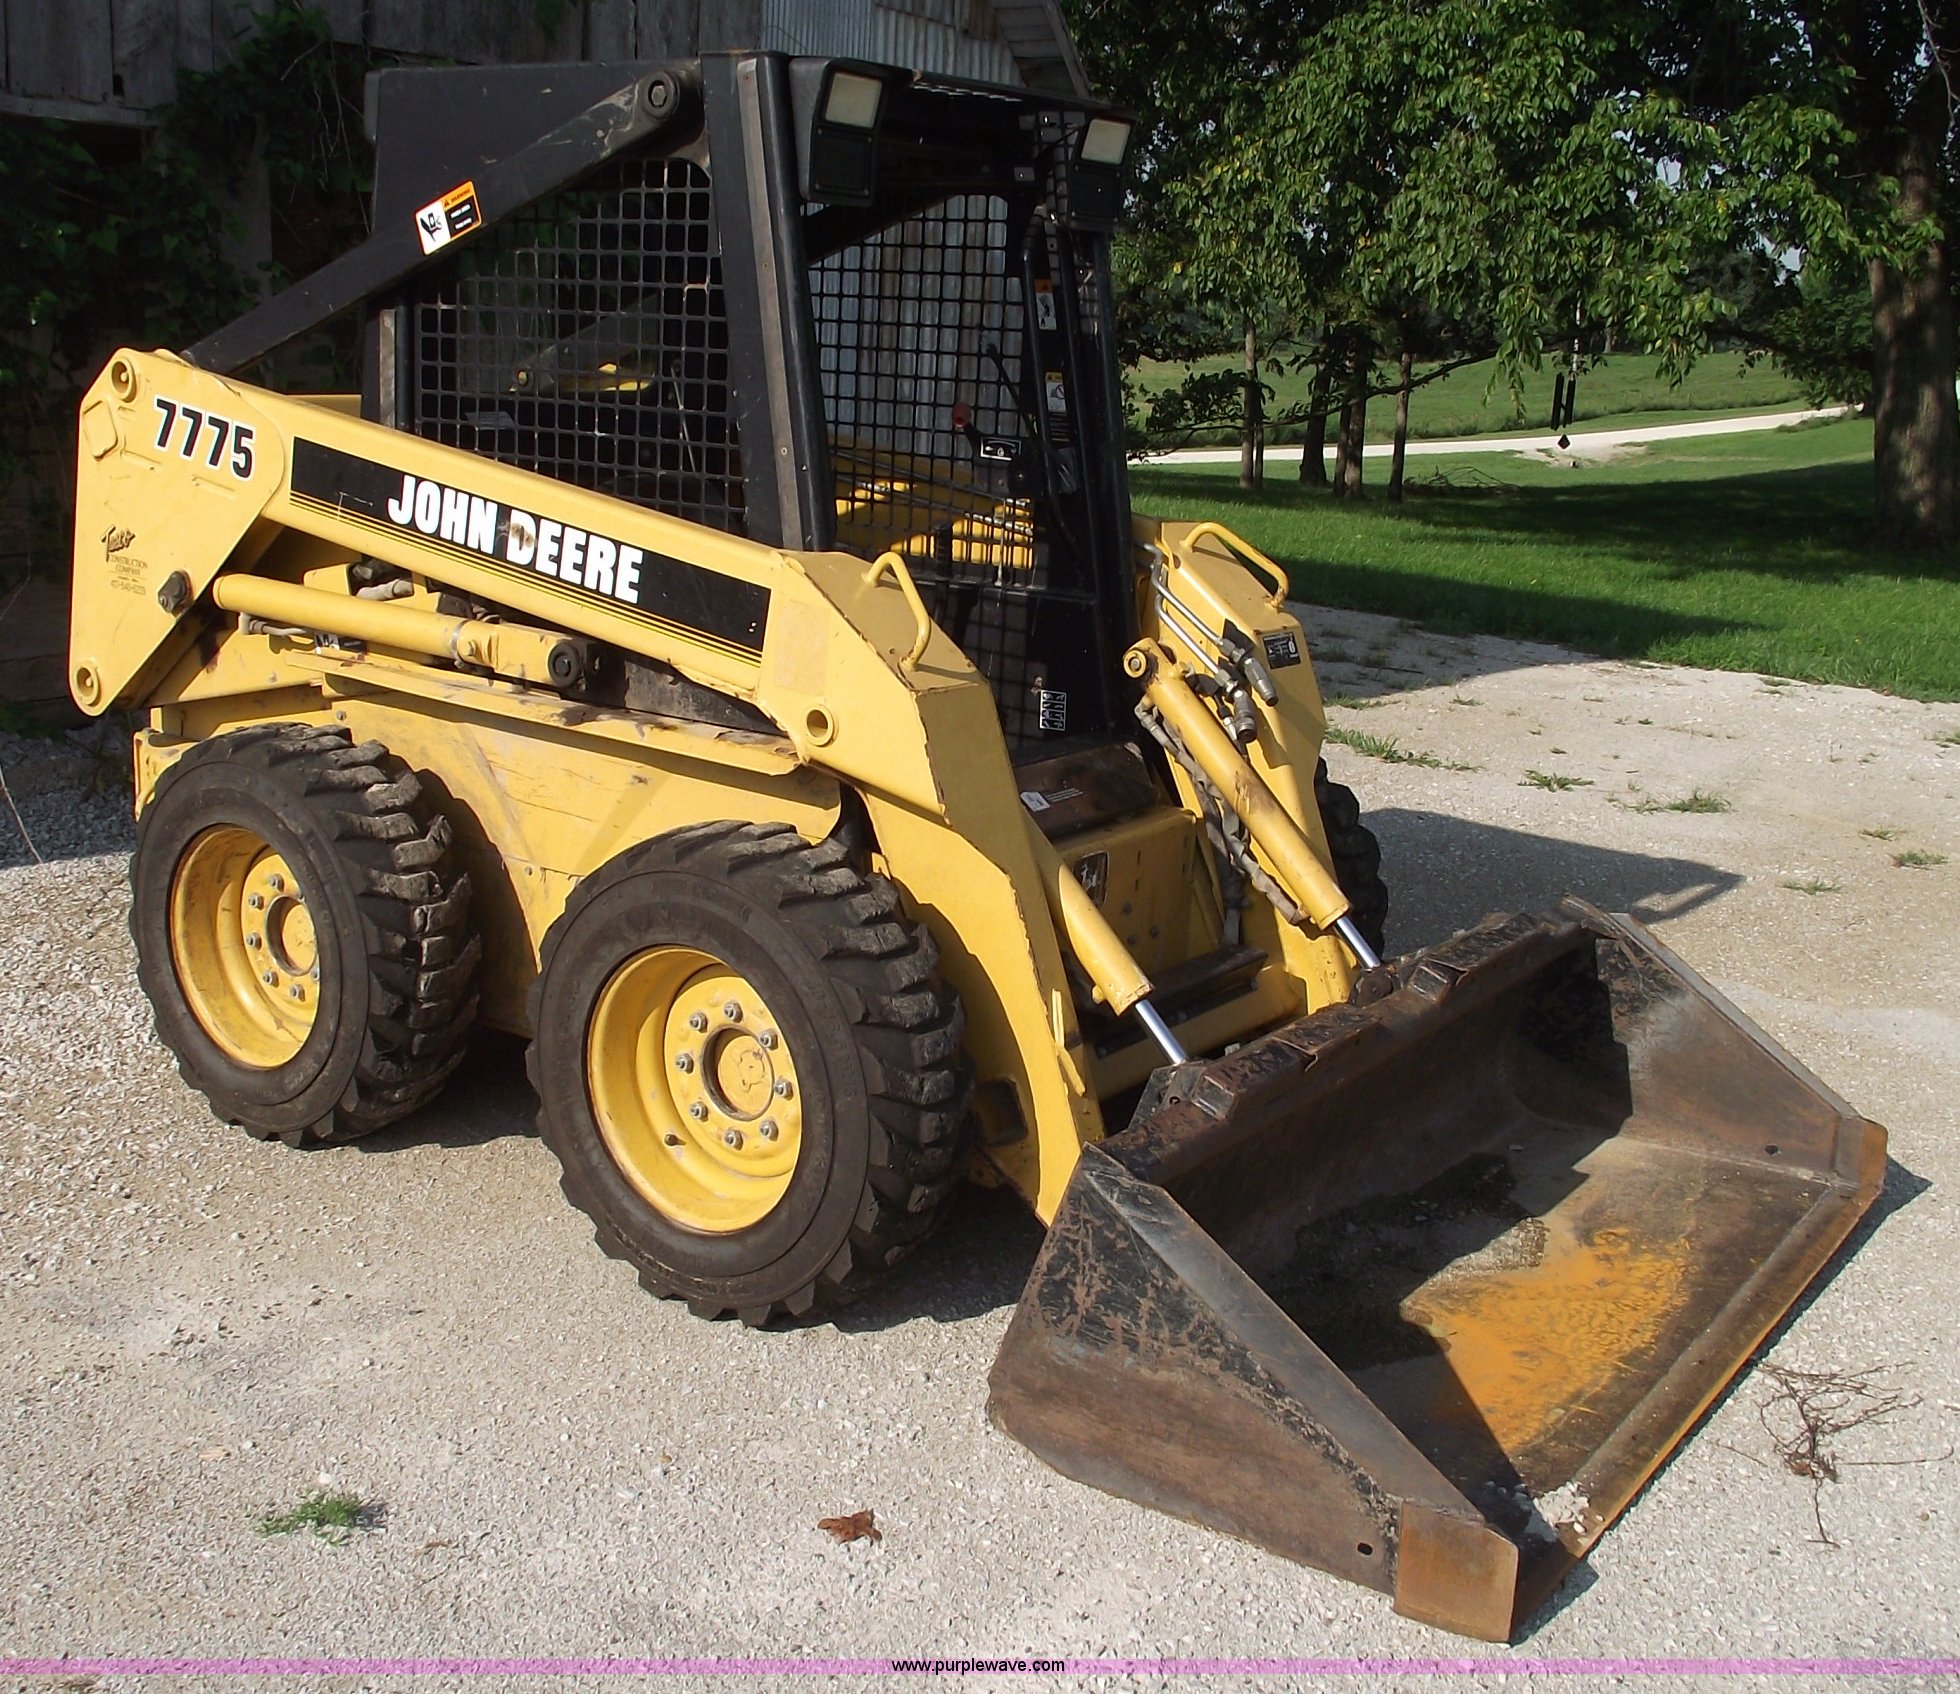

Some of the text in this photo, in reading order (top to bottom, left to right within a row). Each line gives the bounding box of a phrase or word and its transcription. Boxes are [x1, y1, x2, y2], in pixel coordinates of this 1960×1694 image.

[155, 396, 256, 480] 7775
[387, 474, 645, 604] JOHN DEERE
